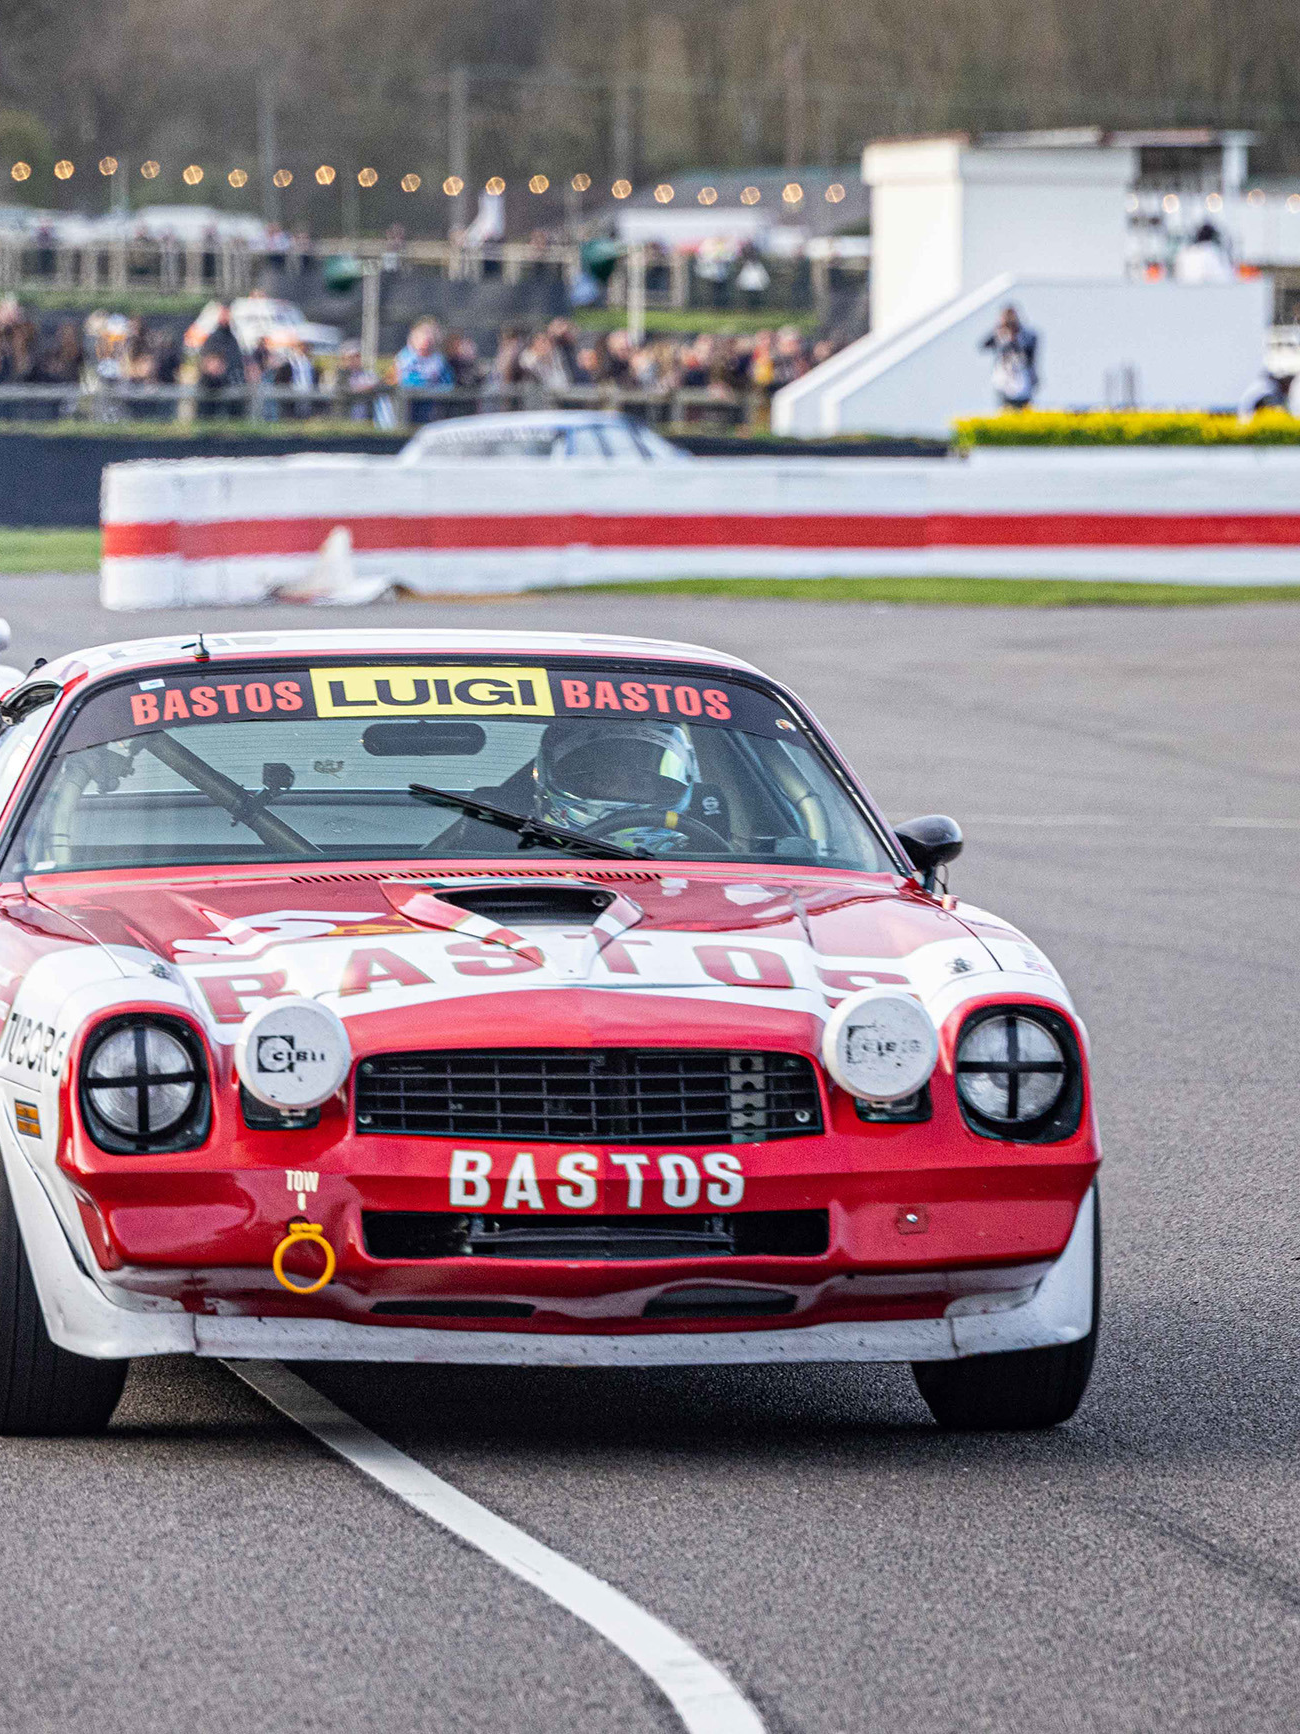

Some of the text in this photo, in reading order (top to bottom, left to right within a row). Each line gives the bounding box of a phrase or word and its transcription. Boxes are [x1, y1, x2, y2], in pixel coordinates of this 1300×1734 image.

[130, 678, 732, 726] BASTOS LUIGI BASTOS
[1, 1012, 66, 1077] TUBORG
[285, 1169, 319, 1193] TOW
[450, 1149, 745, 1210] BASTOS
